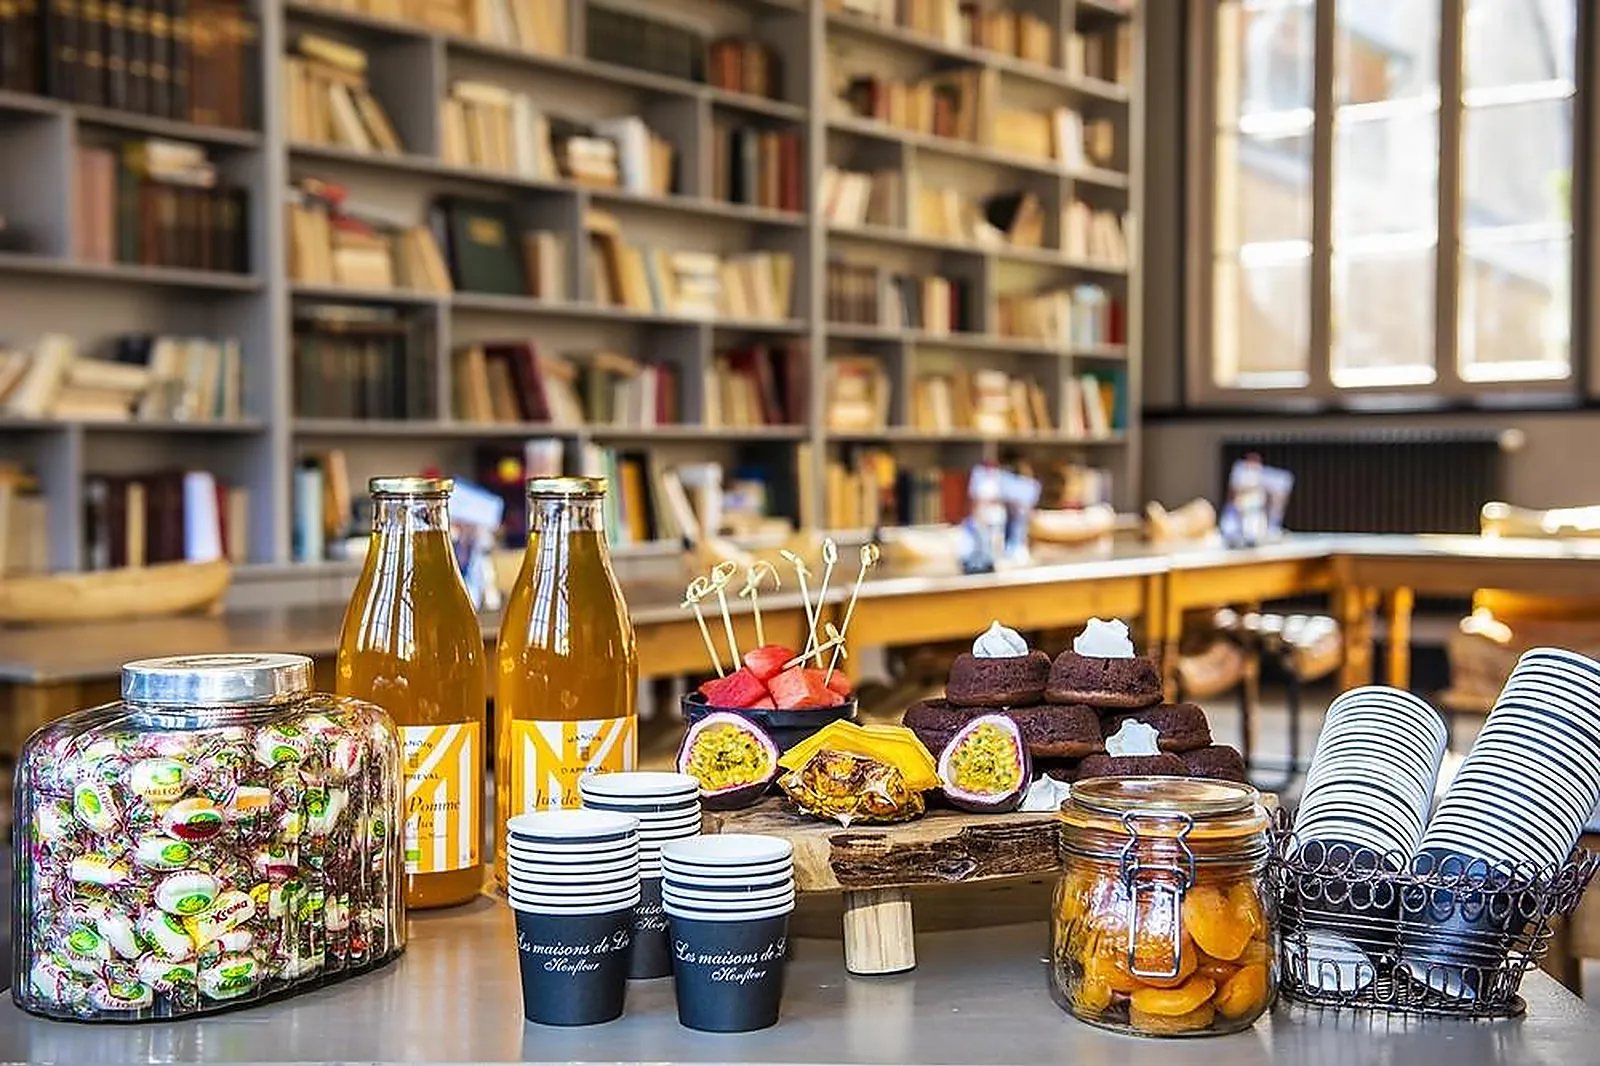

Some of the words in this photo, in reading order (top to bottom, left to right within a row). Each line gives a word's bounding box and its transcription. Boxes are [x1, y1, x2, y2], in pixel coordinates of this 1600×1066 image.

[409, 796, 460, 812] Pomme
[532, 941, 590, 956] maisons
[592, 936, 609, 954] de
[675, 940, 696, 963] Les
[698, 950, 758, 965] maisons
[760, 944, 774, 961] de
[543, 957, 600, 976] Honfleur
[711, 966, 766, 985] Honfleur
